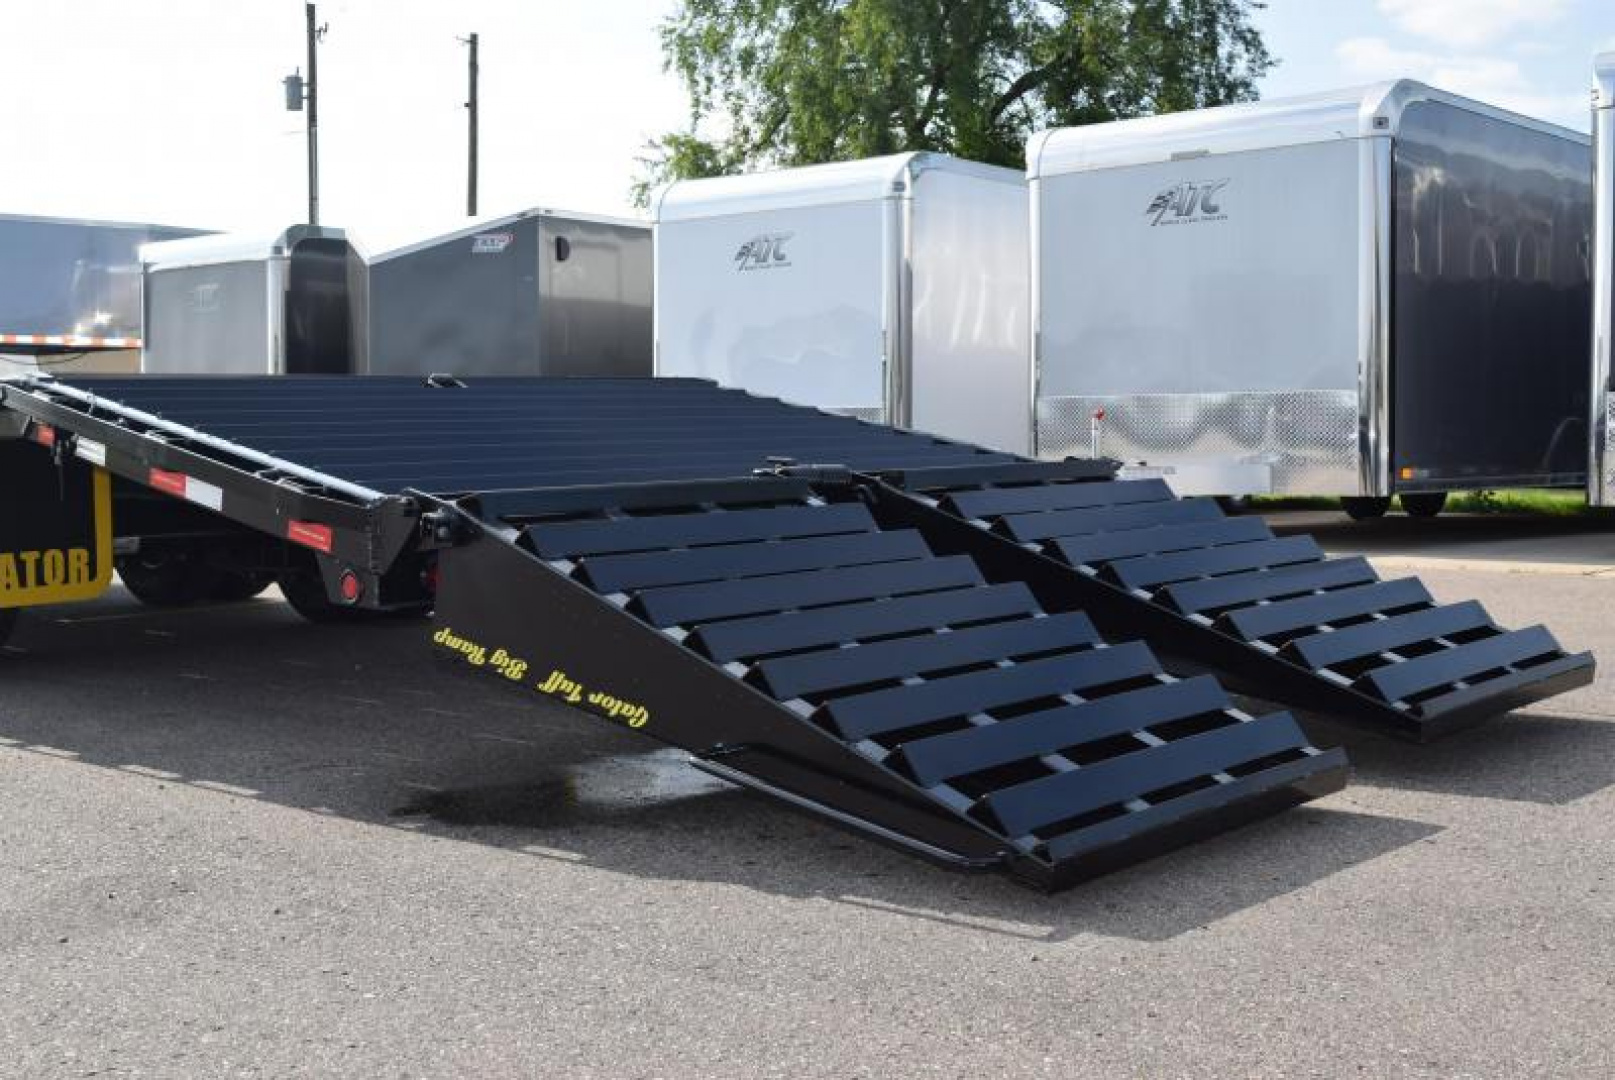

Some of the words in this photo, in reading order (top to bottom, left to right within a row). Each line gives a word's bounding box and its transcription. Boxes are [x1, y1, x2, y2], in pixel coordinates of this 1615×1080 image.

[433, 627, 486, 665] Ramp
[489, 648, 528, 680] Big
[537, 670, 583, 702] Tuff
[588, 692, 649, 728] Gator
